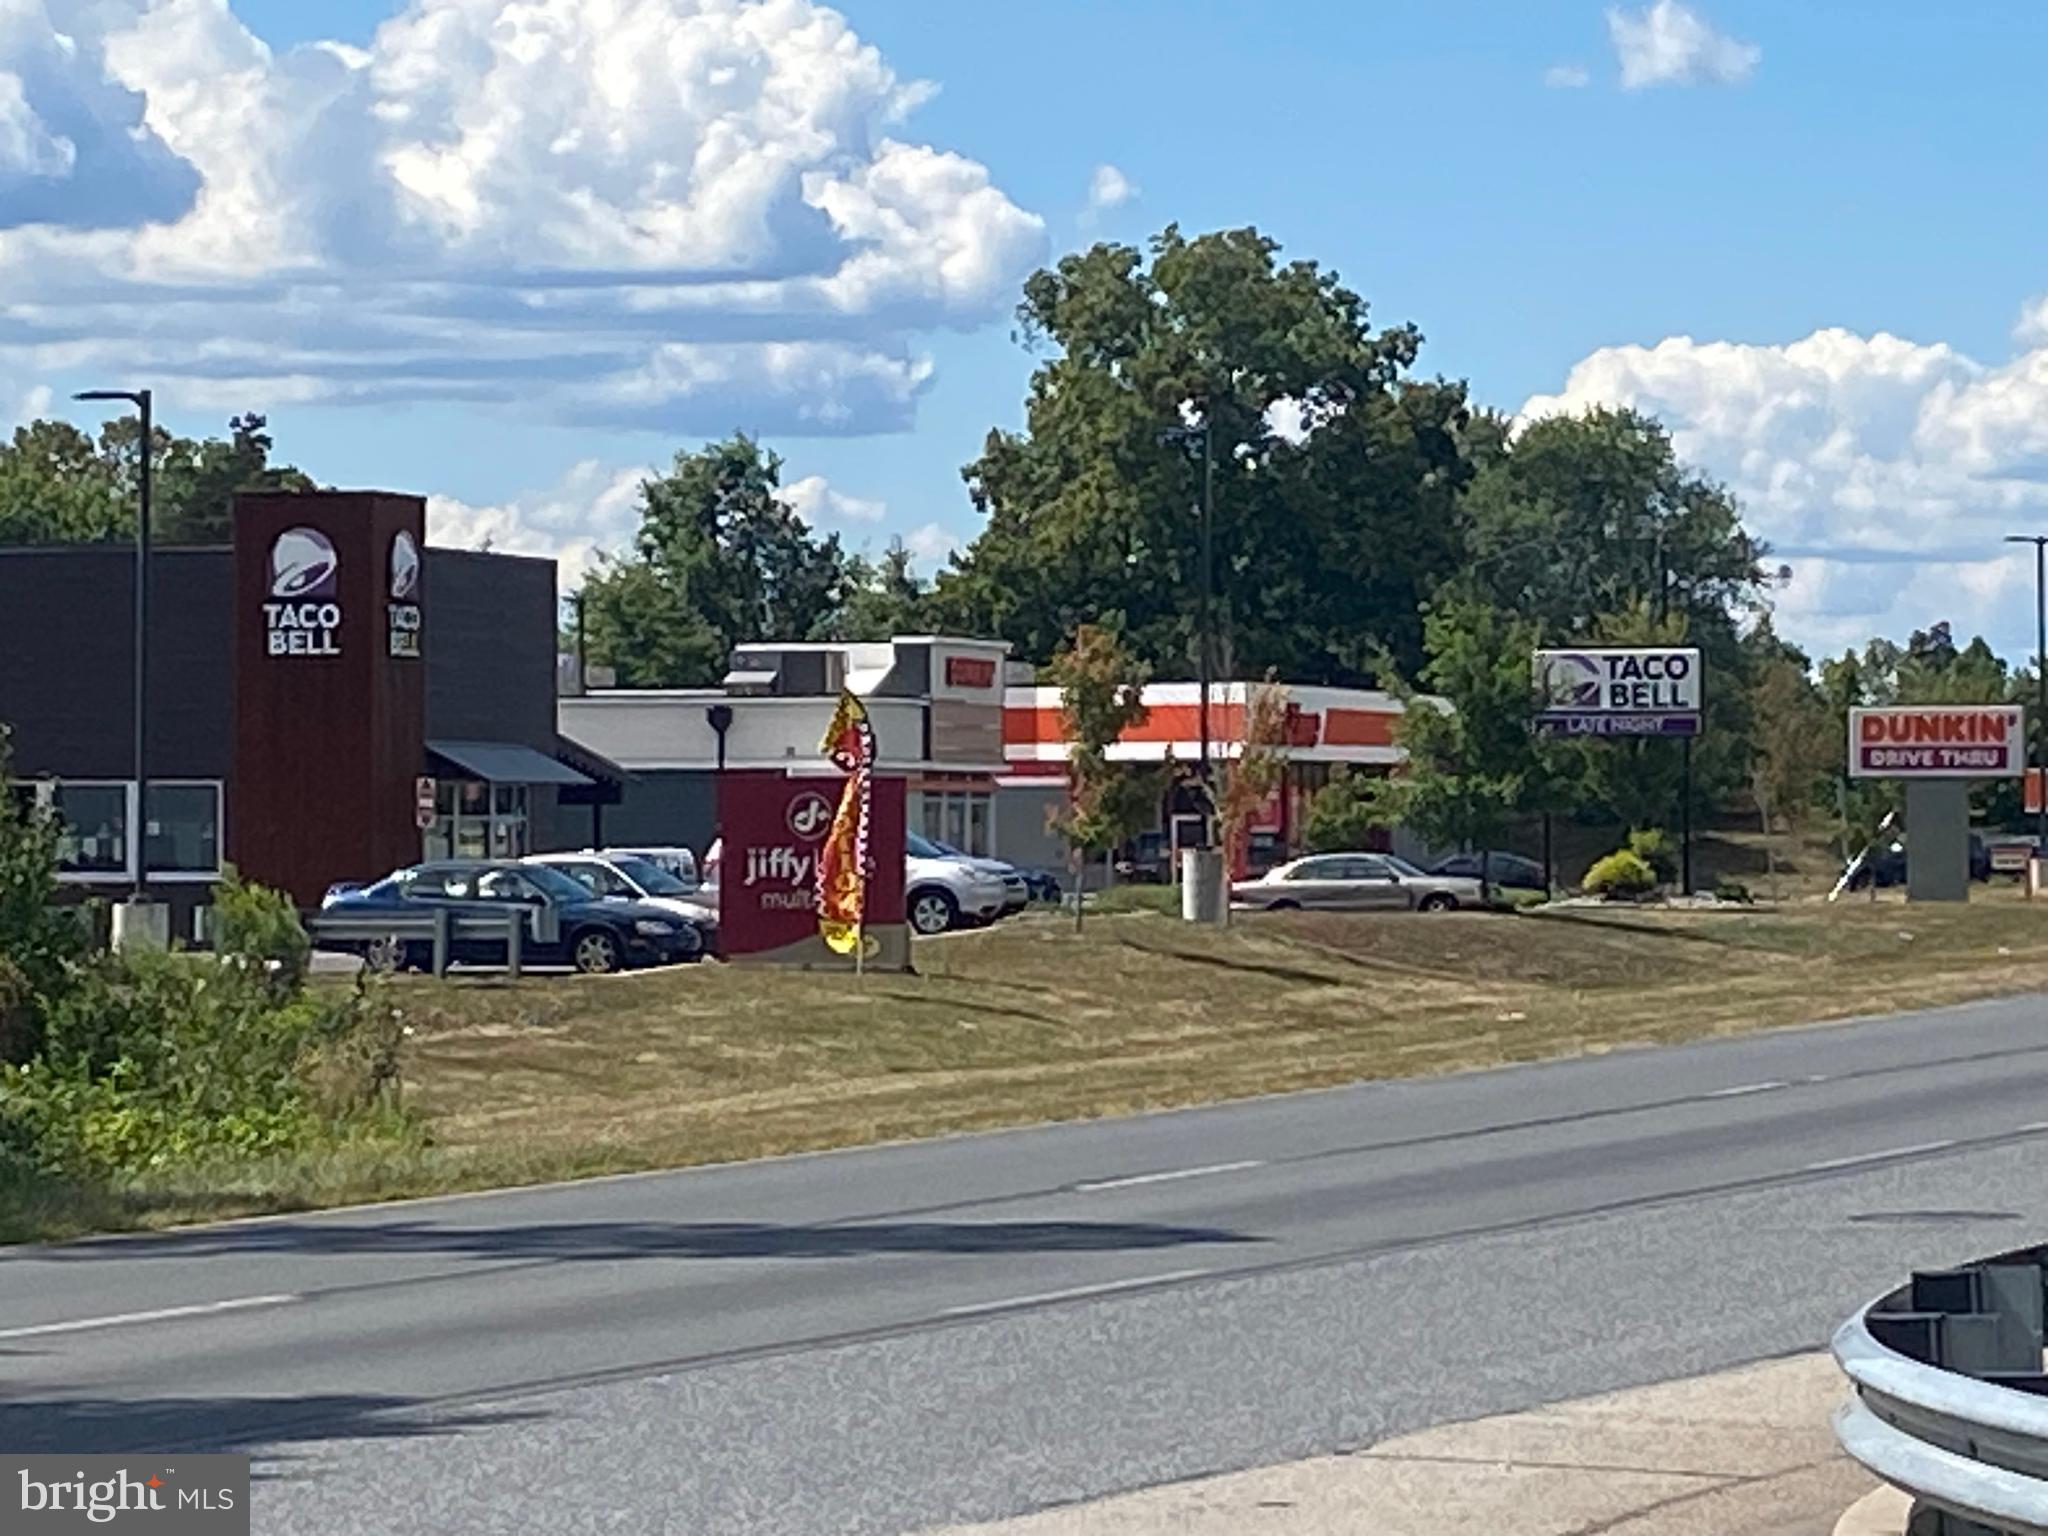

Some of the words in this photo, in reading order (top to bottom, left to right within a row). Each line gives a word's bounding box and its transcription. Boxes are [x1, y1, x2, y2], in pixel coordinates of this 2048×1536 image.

[262, 603, 340, 629] TACO
[268, 630, 341, 655] BELL
[1602, 655, 1690, 680] TACO
[1610, 683, 1689, 707] BELL
[1862, 714, 2017, 742] DUNKIN'
[1870, 750, 1934, 767] DRIVE
[1939, 750, 1998, 767] THRU
[744, 848, 810, 886] jiffy
